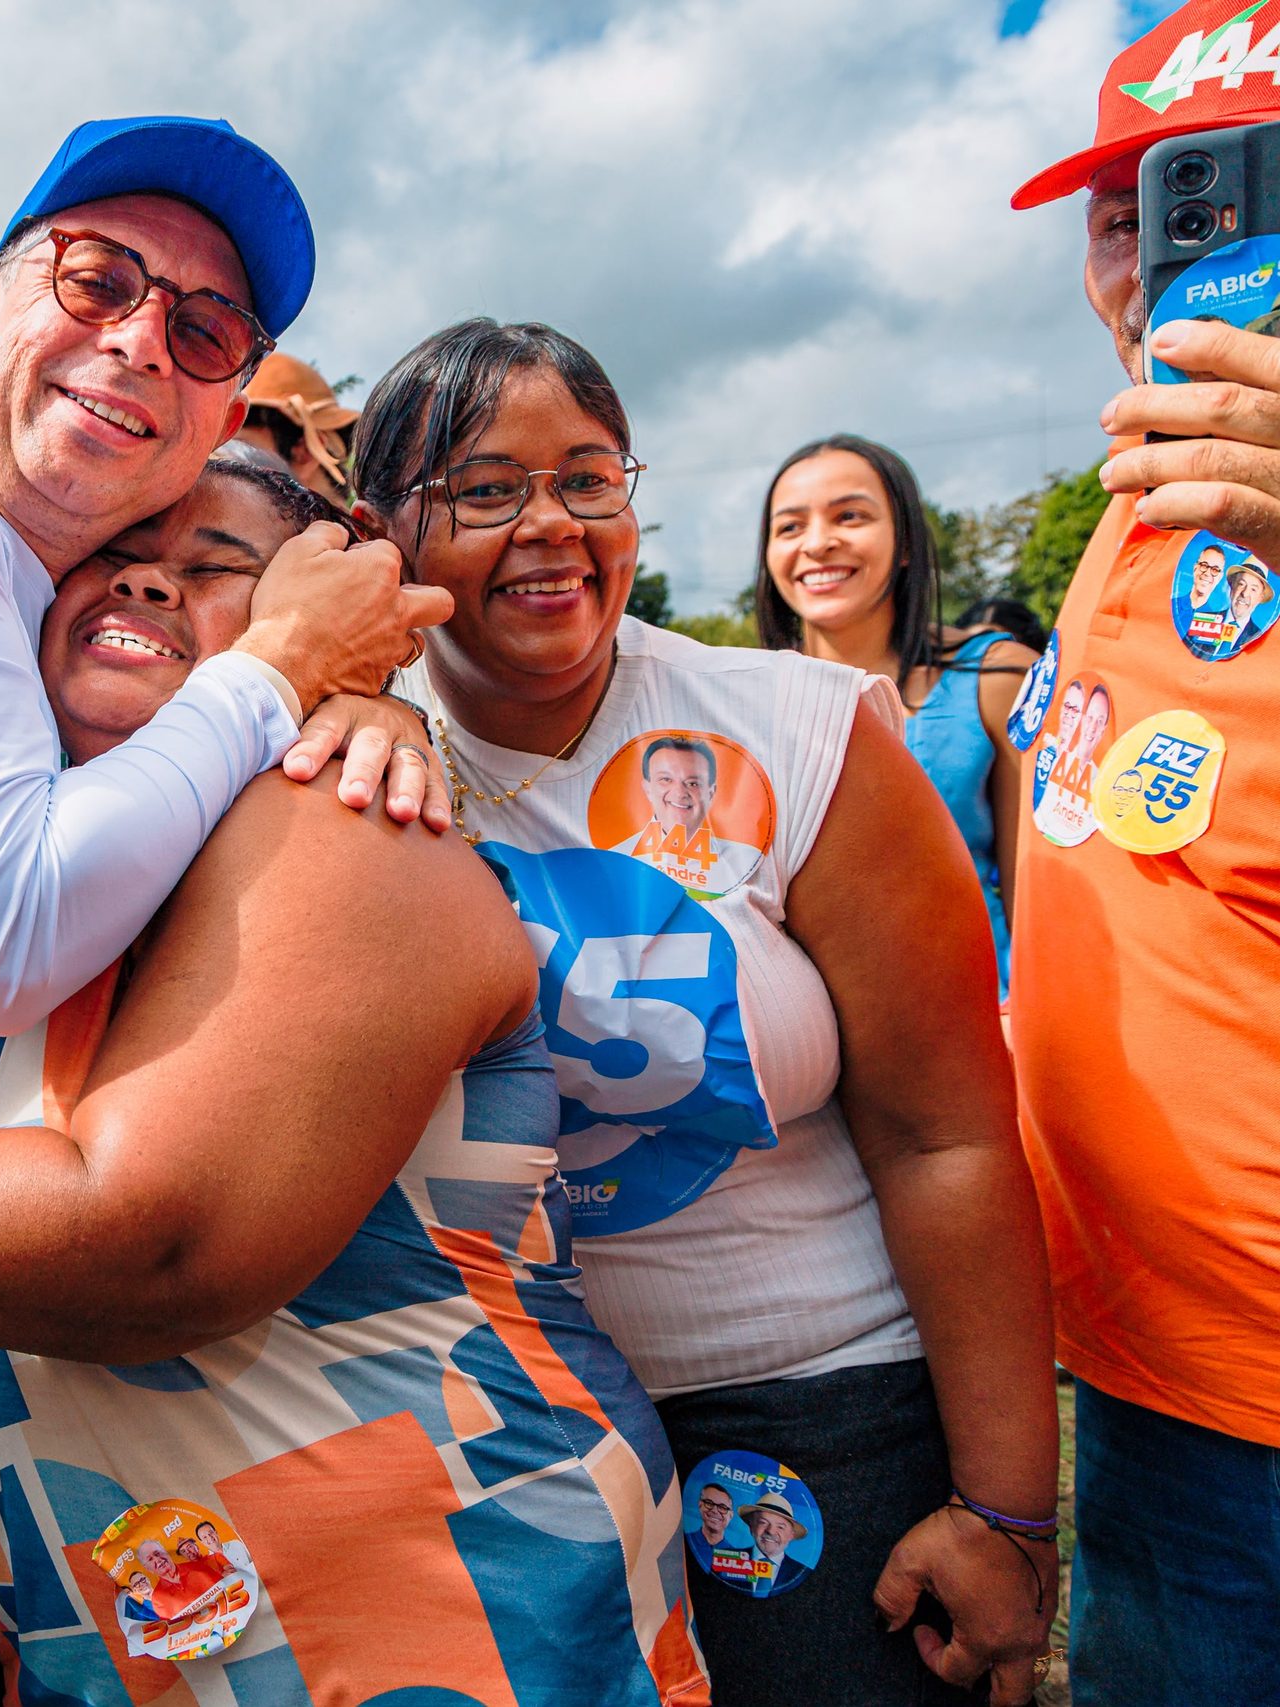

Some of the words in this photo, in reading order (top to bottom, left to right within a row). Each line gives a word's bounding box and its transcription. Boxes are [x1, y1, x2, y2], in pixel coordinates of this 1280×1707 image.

[1223, 624, 1235, 637] 13
[1141, 735, 1207, 775] FAZ
[1048, 750, 1093, 812] 444
[1144, 773, 1200, 811] 55
[631, 821, 718, 871] 444
[567, 1184, 618, 1204] BIO
[572, 1203, 608, 1211] NADOR
[713, 1463, 765, 1487] FÁBIO
[765, 1475, 788, 1490] 55
[163, 1515, 183, 1538] psd
[713, 1556, 754, 1571] LULA
[756, 1562, 769, 1573] 13
[192, 1585, 223, 1611] ESTADUAL
